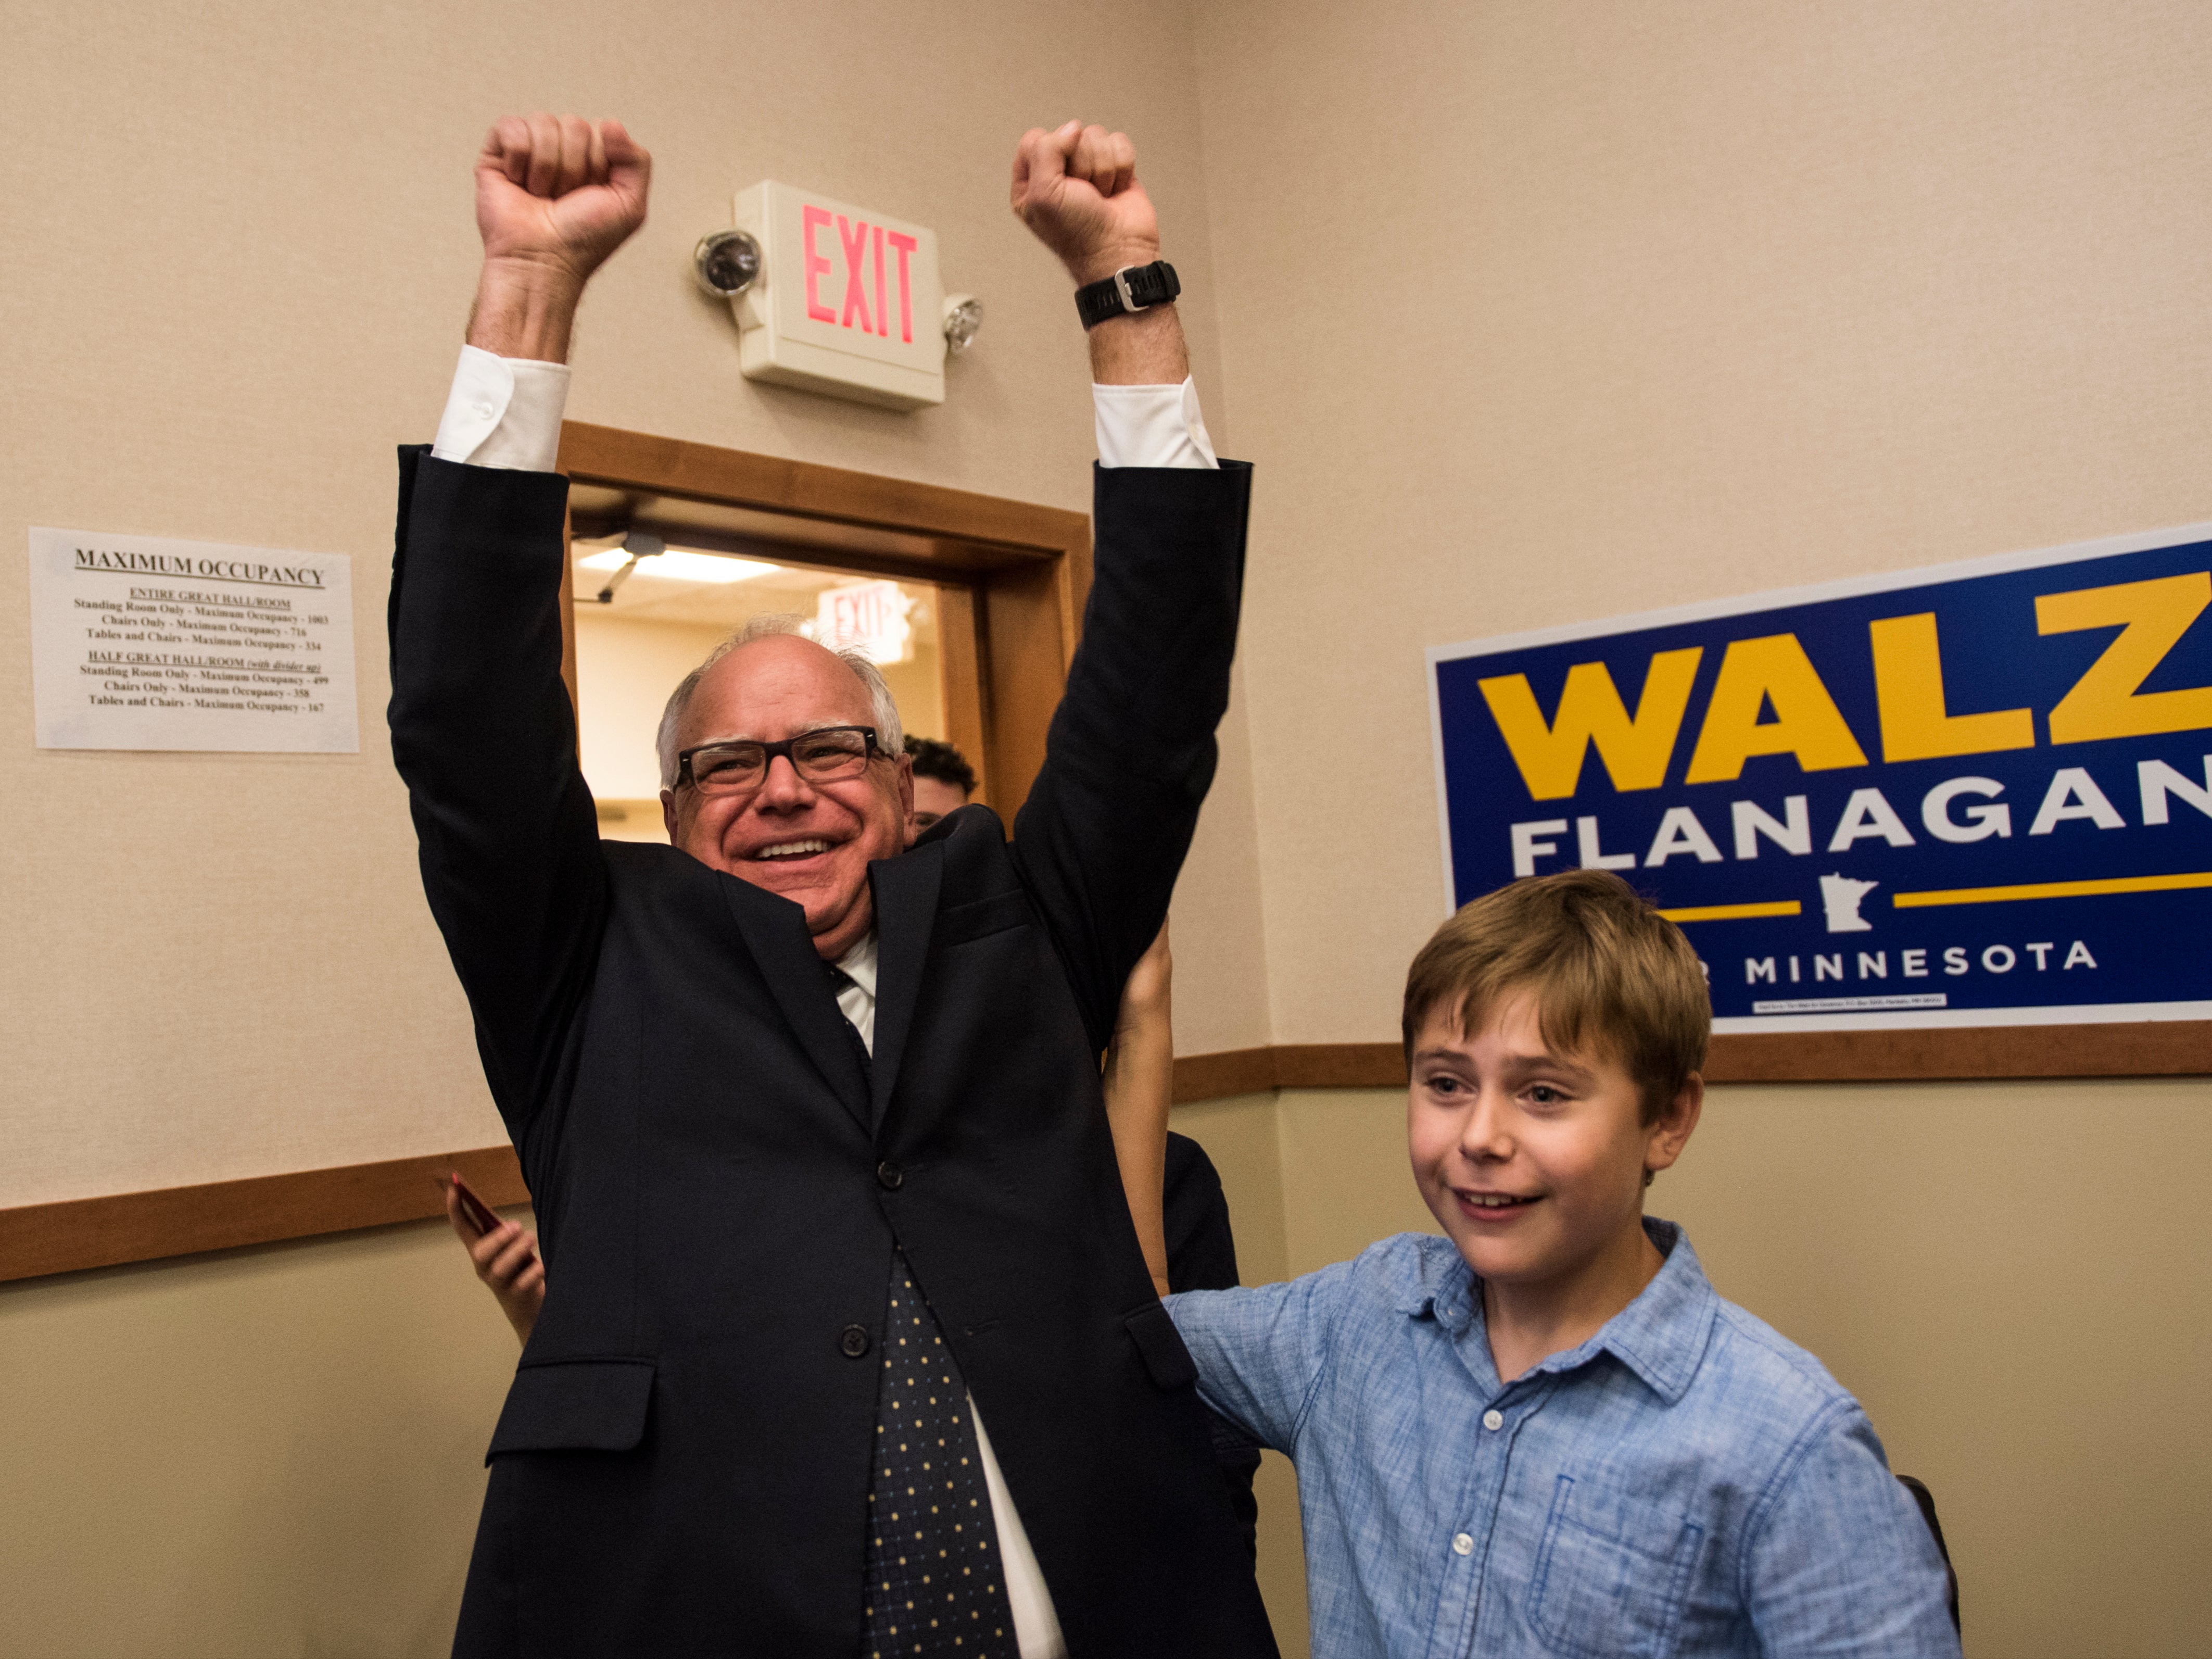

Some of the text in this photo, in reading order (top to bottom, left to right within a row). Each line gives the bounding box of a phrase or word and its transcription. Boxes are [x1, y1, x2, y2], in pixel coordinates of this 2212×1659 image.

[802, 204, 918, 344] EXIT
[76, 548, 323, 585] MAXIMUM OCCUPANCY
[130, 587, 291, 608] ENTIRE GREAT HALL/ROOM
[74, 598, 122, 612] Standing
[126, 601, 157, 612] Room
[160, 604, 184, 616] Only
[195, 606, 244, 619] Maximum
[247, 610, 297, 623] Occupancy
[835, 585, 884, 646] EXIT
[102, 614, 137, 626] Chairs
[140, 617, 165, 629] Only
[176, 619, 227, 631] Maximum
[230, 623, 281, 636] Occupancy
[86, 628, 122, 640] Tables
[125, 631, 144, 642] and
[147, 632, 182, 643] Chairs
[192, 634, 242, 647] Maximum
[244, 637, 295, 651] Occupancy
[89, 650, 123, 662] HALF
[127, 652, 168, 663] GREAT
[172, 654, 245, 667] HALL/ROOM
[247, 659, 270, 670] (with
[273, 660, 303, 670] divider
[80, 664, 129, 677] Standing
[132, 667, 162, 677] Room
[165, 669, 189, 681] Only
[200, 670, 250, 682] Maximum
[252, 673, 303, 686] Occupancy
[1476, 571, 2212, 801] WALZ
[104, 680, 140, 692] Chairs
[143, 682, 168, 695] Only
[179, 683, 230, 695] Maximum
[232, 686, 284, 699] Occupancy
[89, 695, 124, 706] Tables
[127, 696, 146, 706] and
[150, 696, 185, 708] Chairs
[194, 698, 245, 710] Maximum
[247, 700, 298, 713] Occupancy
[1511, 754, 2212, 878] FLANAGAN
[1745, 941, 2097, 985] MINNESOTA
